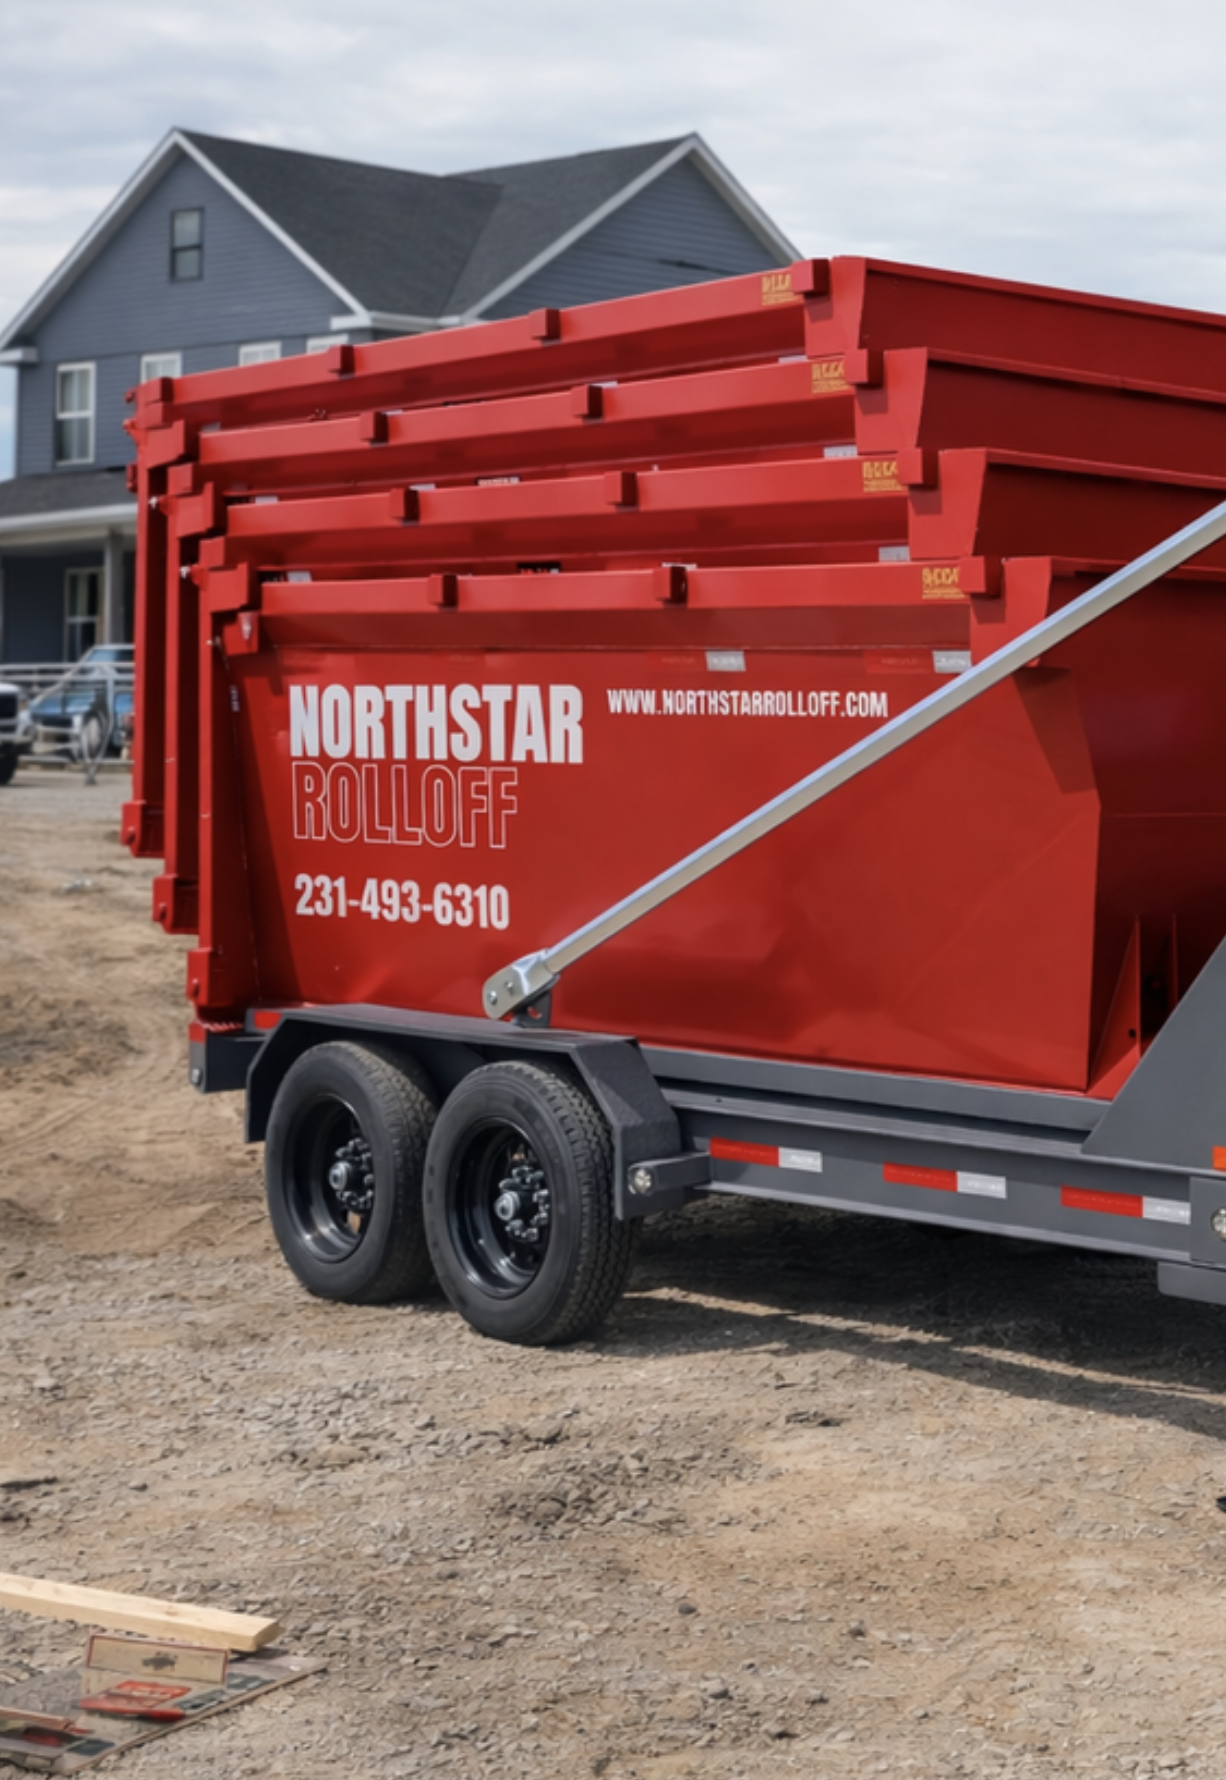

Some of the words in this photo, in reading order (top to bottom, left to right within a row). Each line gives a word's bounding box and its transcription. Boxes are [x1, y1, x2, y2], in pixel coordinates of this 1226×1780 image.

[290, 684, 583, 763] NORTHSTAR
[607, 688, 888, 717] WWW.NORTHSTARROLLOFF.COM
[292, 761, 518, 848] ROLLOFF
[294, 873, 509, 930] 231-493-6310
